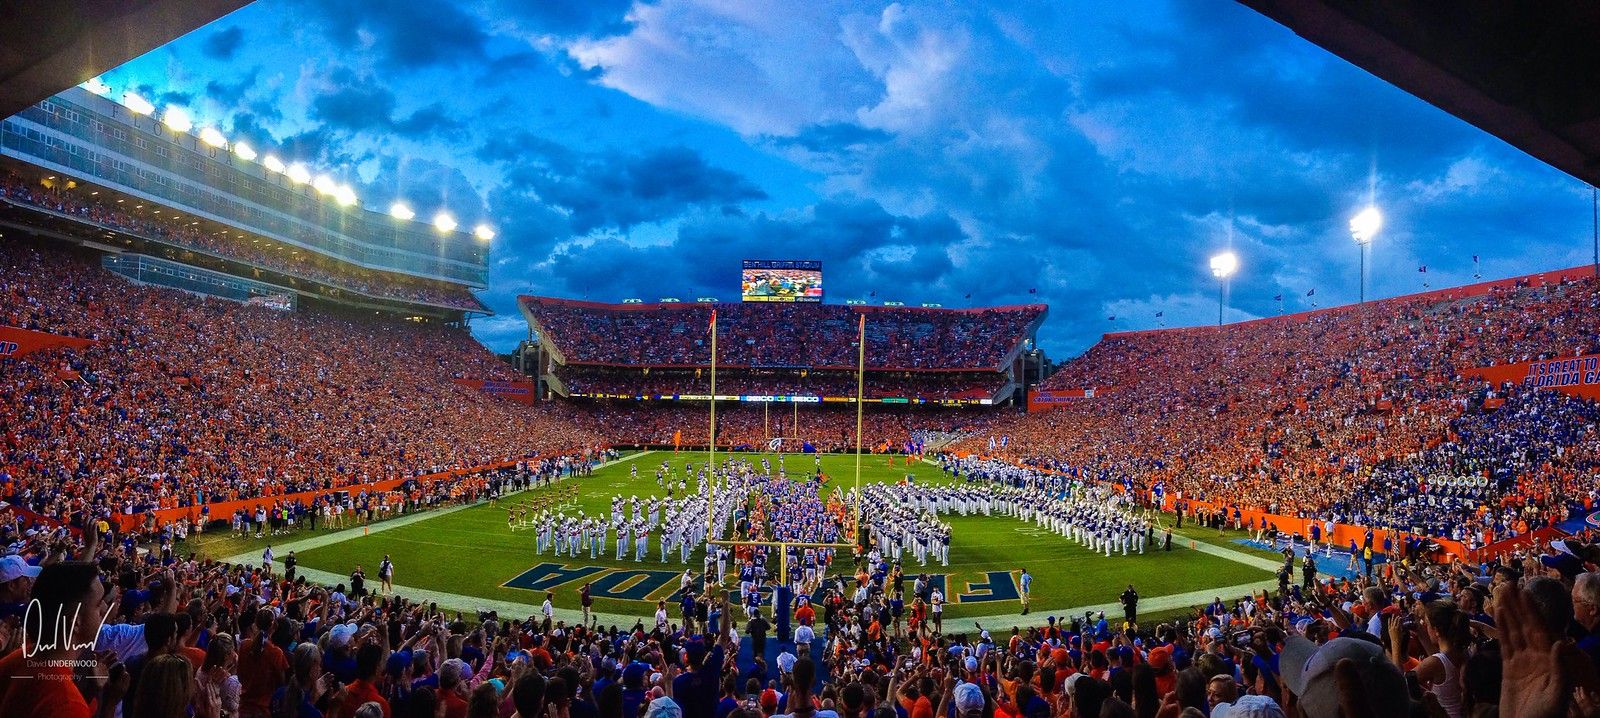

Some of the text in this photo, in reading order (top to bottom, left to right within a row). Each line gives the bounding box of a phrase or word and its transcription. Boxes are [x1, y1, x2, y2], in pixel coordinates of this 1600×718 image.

[1548, 359, 1582, 374] GREAT
[1583, 357, 1598, 371] TO
[1524, 372, 1580, 387] FLORIDA
[743, 567, 753, 577] 74
